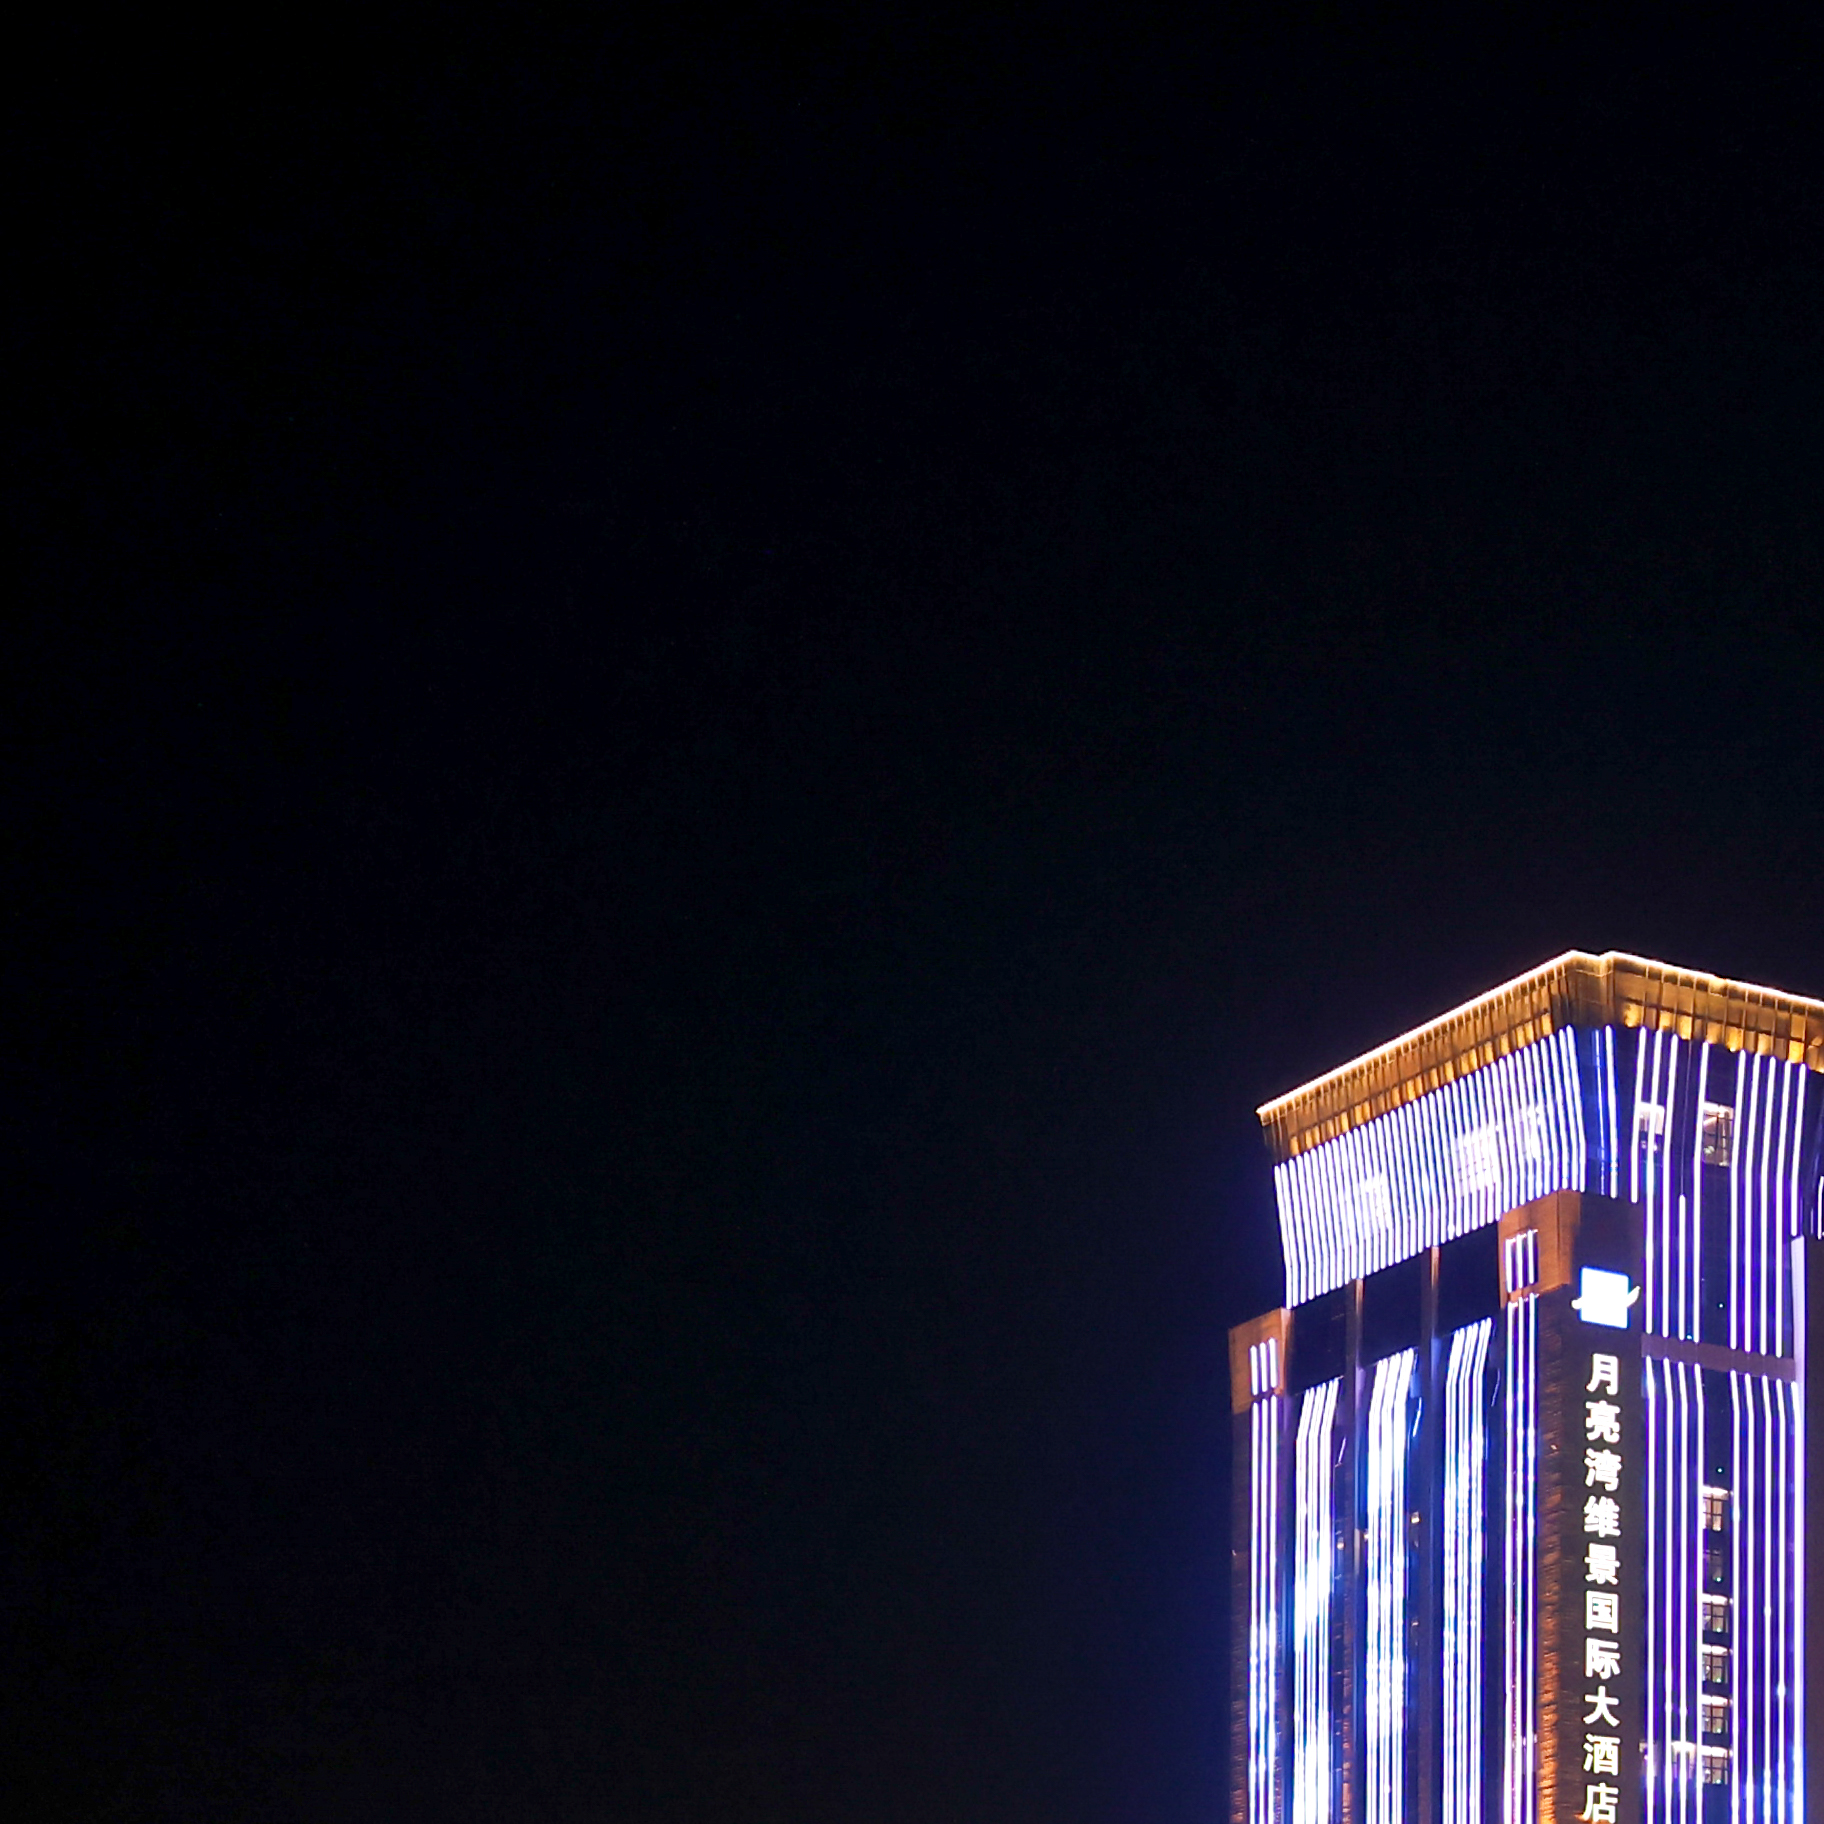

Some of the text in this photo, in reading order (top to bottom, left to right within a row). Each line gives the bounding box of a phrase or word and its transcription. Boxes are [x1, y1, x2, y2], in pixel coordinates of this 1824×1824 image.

[1584, 1352, 1622, 1824] 月亮湾维景国际大酒店
